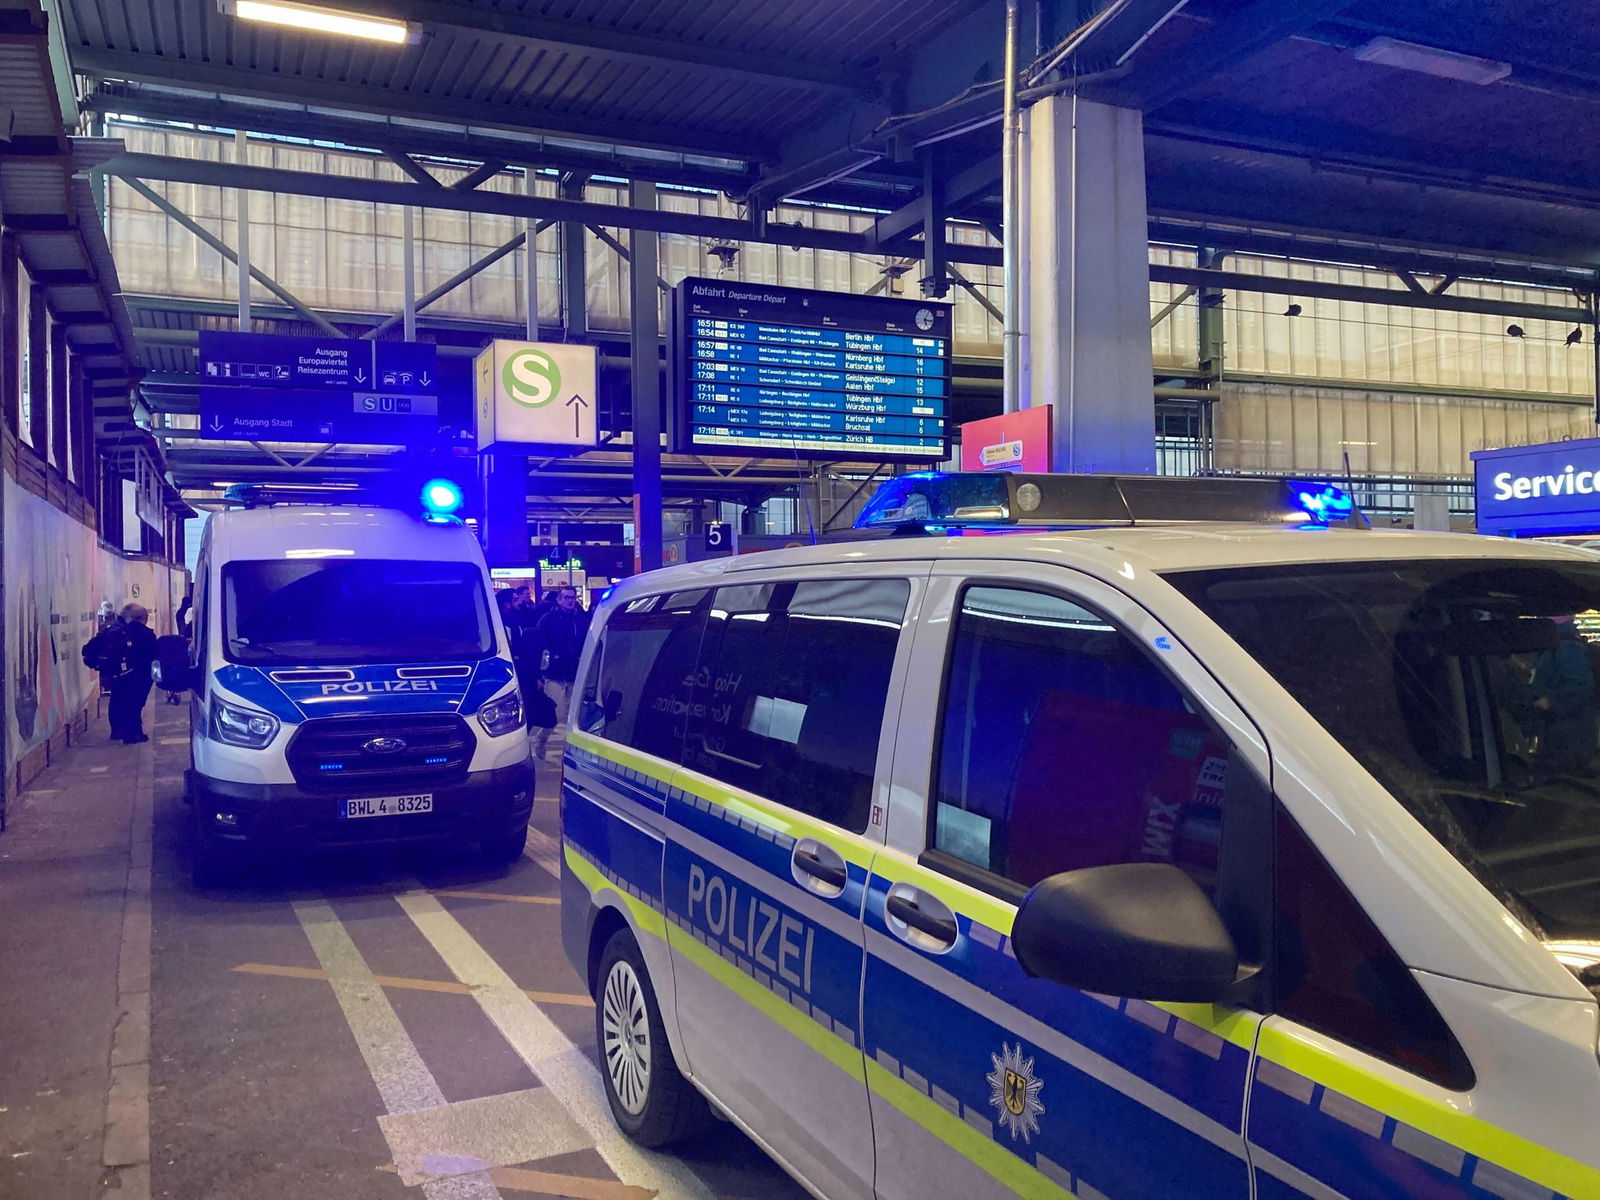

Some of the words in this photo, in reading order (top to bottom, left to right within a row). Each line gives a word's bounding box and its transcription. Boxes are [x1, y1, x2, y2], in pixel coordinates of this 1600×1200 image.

[692, 286, 726, 298] Abfahrt
[728, 290, 762, 301] Departure
[763, 294, 786, 304] Départ
[697, 320, 715, 328] 16:51
[846, 332, 862, 341] Berlin
[697, 328, 715, 336] 16:54
[846, 342, 872, 351] Tübingen
[872, 343, 882, 351] Hbf
[298, 356, 348, 366] Europaviertel
[315, 348, 348, 358] Ausgang
[697, 341, 715, 350] 16:57
[846, 353, 872, 364] Nürnberg
[697, 350, 715, 358] 16:58
[846, 362, 874, 370] Karlsruhe
[874, 364, 885, 372] Hbf
[297, 366, 348, 376] Reisezentrum
[512, 354, 552, 404] S
[697, 362, 715, 370] 17:03
[846, 374, 896, 385] Geislingen(Steige)
[697, 372, 715, 380] 17:08
[846, 382, 862, 390] Aalen
[698, 384, 715, 392] 17:11
[846, 394, 872, 404] Tübingen
[698, 392, 715, 400] 17:11
[846, 402, 875, 412] Würzburg
[364, 398, 376, 410] S
[382, 398, 392, 411] U
[234, 417, 270, 428] Ausgang
[271, 418, 293, 428] Stadt
[698, 406, 716, 414] 17:14
[846, 415, 874, 423] Karlsruhe
[698, 427, 716, 435] 17:16
[846, 434, 864, 442] Zürich
[846, 423, 870, 432] Bruchsal
[709, 526, 722, 545] 5
[550, 547, 560, 560] 4
[322, 680, 438, 694] POLIZEI
[348, 800, 376, 816] BWL
[378, 800, 386, 813] 4
[398, 796, 431, 812] 8325
[688, 864, 814, 994] POLIZEI
